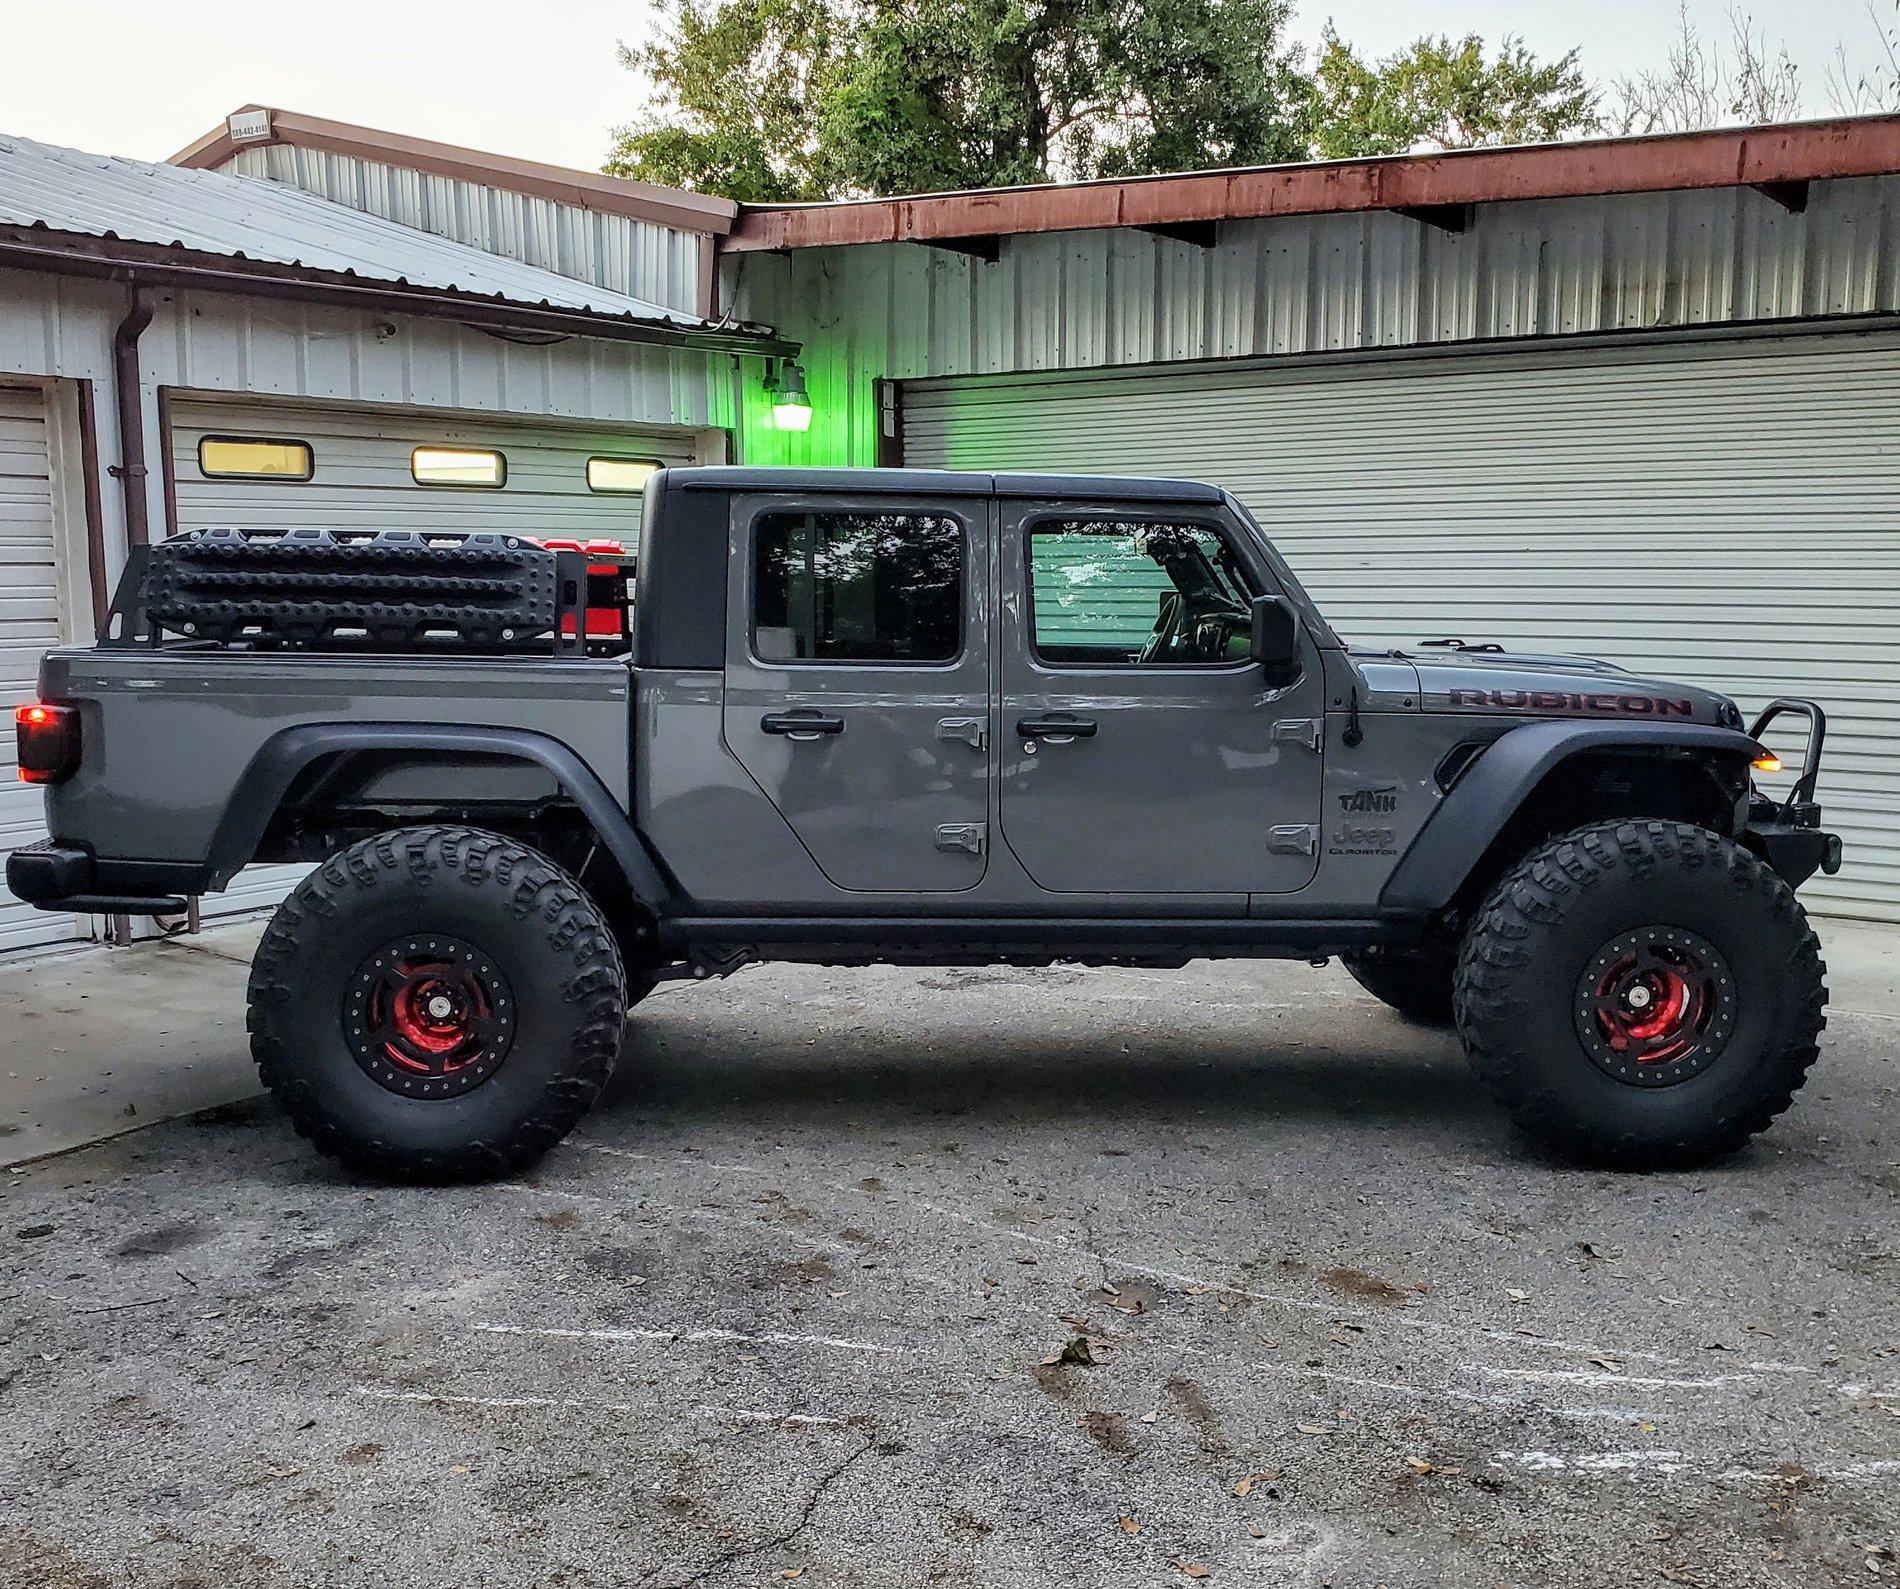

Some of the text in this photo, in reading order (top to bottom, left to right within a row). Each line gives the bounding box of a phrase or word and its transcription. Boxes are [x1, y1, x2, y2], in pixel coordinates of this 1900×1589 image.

[1449, 688, 1693, 715] RUBICON
[1338, 789, 1396, 812] TANK
[1333, 823, 1396, 848] Jeep
[1328, 847, 1398, 855] GLADIATOR
